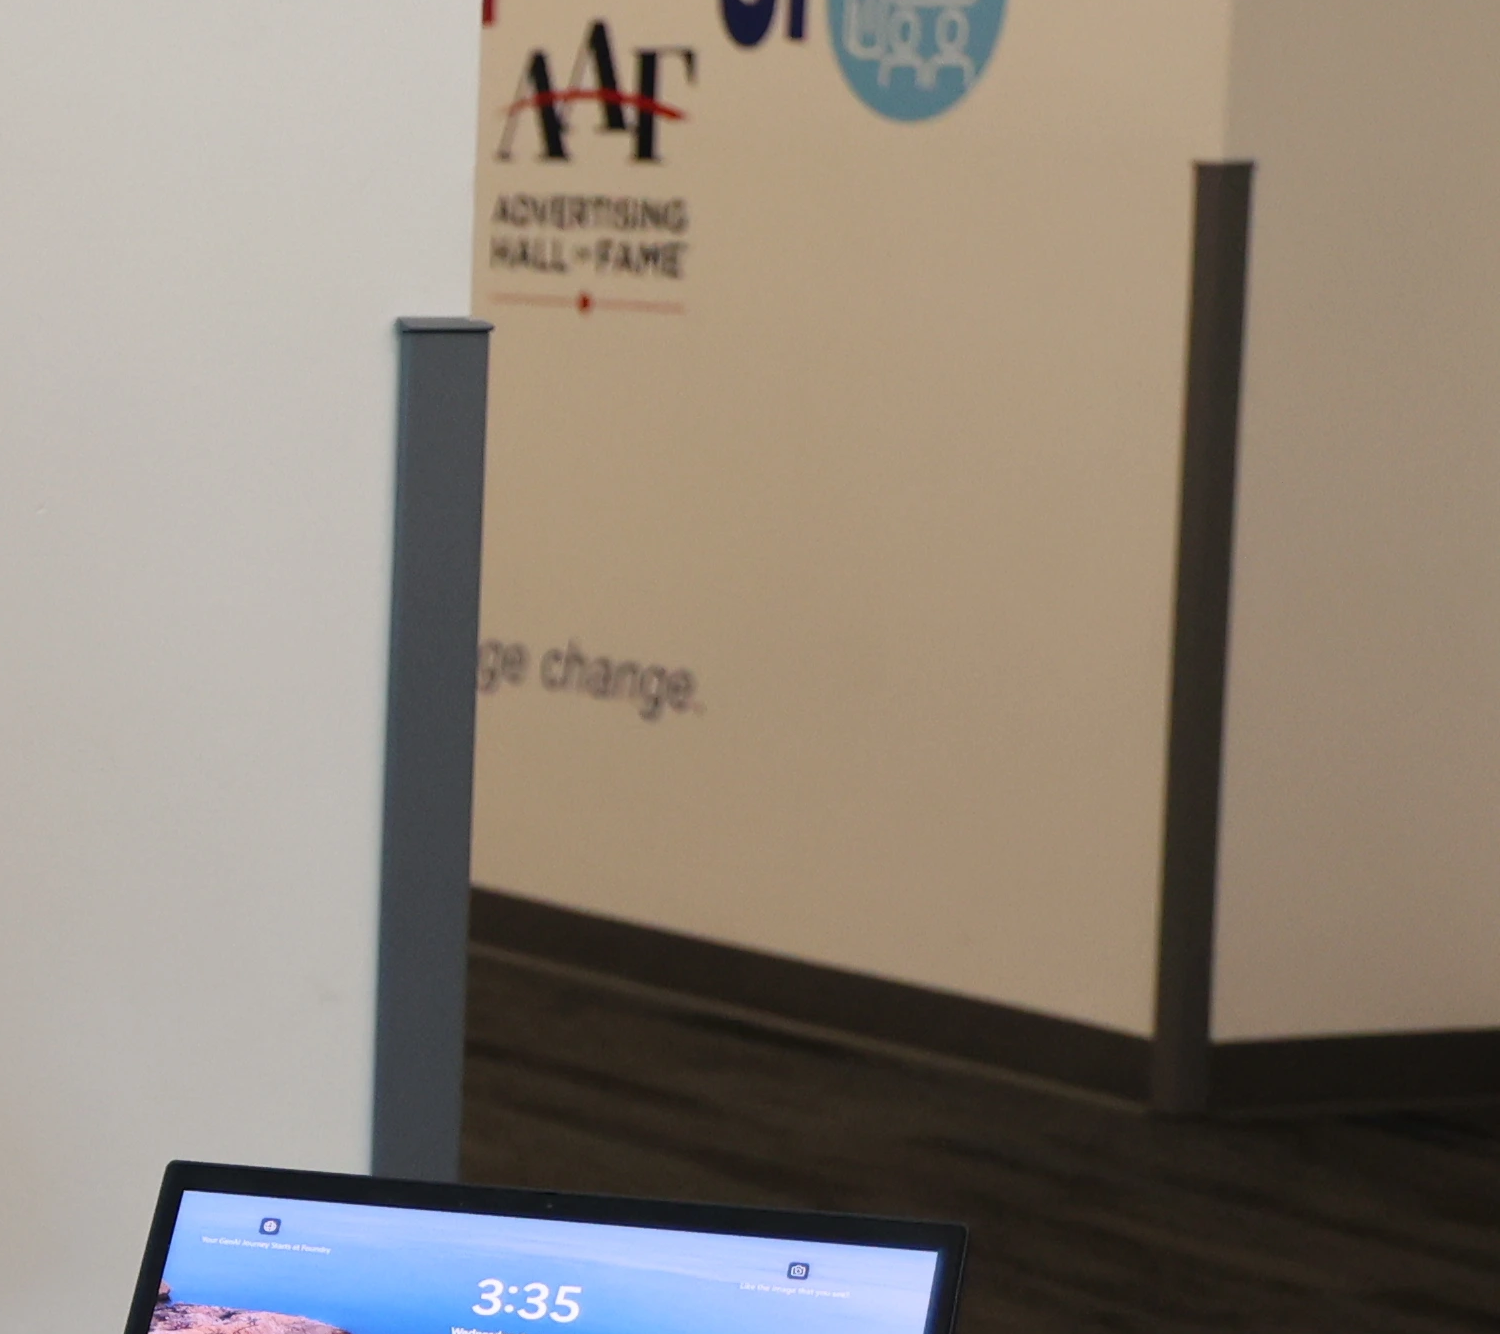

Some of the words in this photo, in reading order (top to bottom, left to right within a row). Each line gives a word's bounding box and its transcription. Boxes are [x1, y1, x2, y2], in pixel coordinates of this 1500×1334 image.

[496, 15, 698, 164] AAF
[492, 194, 690, 236] ADVERTISING
[489, 237, 568, 274] HALL
[594, 239, 688, 281] FAME
[472, 1278, 583, 1323] 3:35
